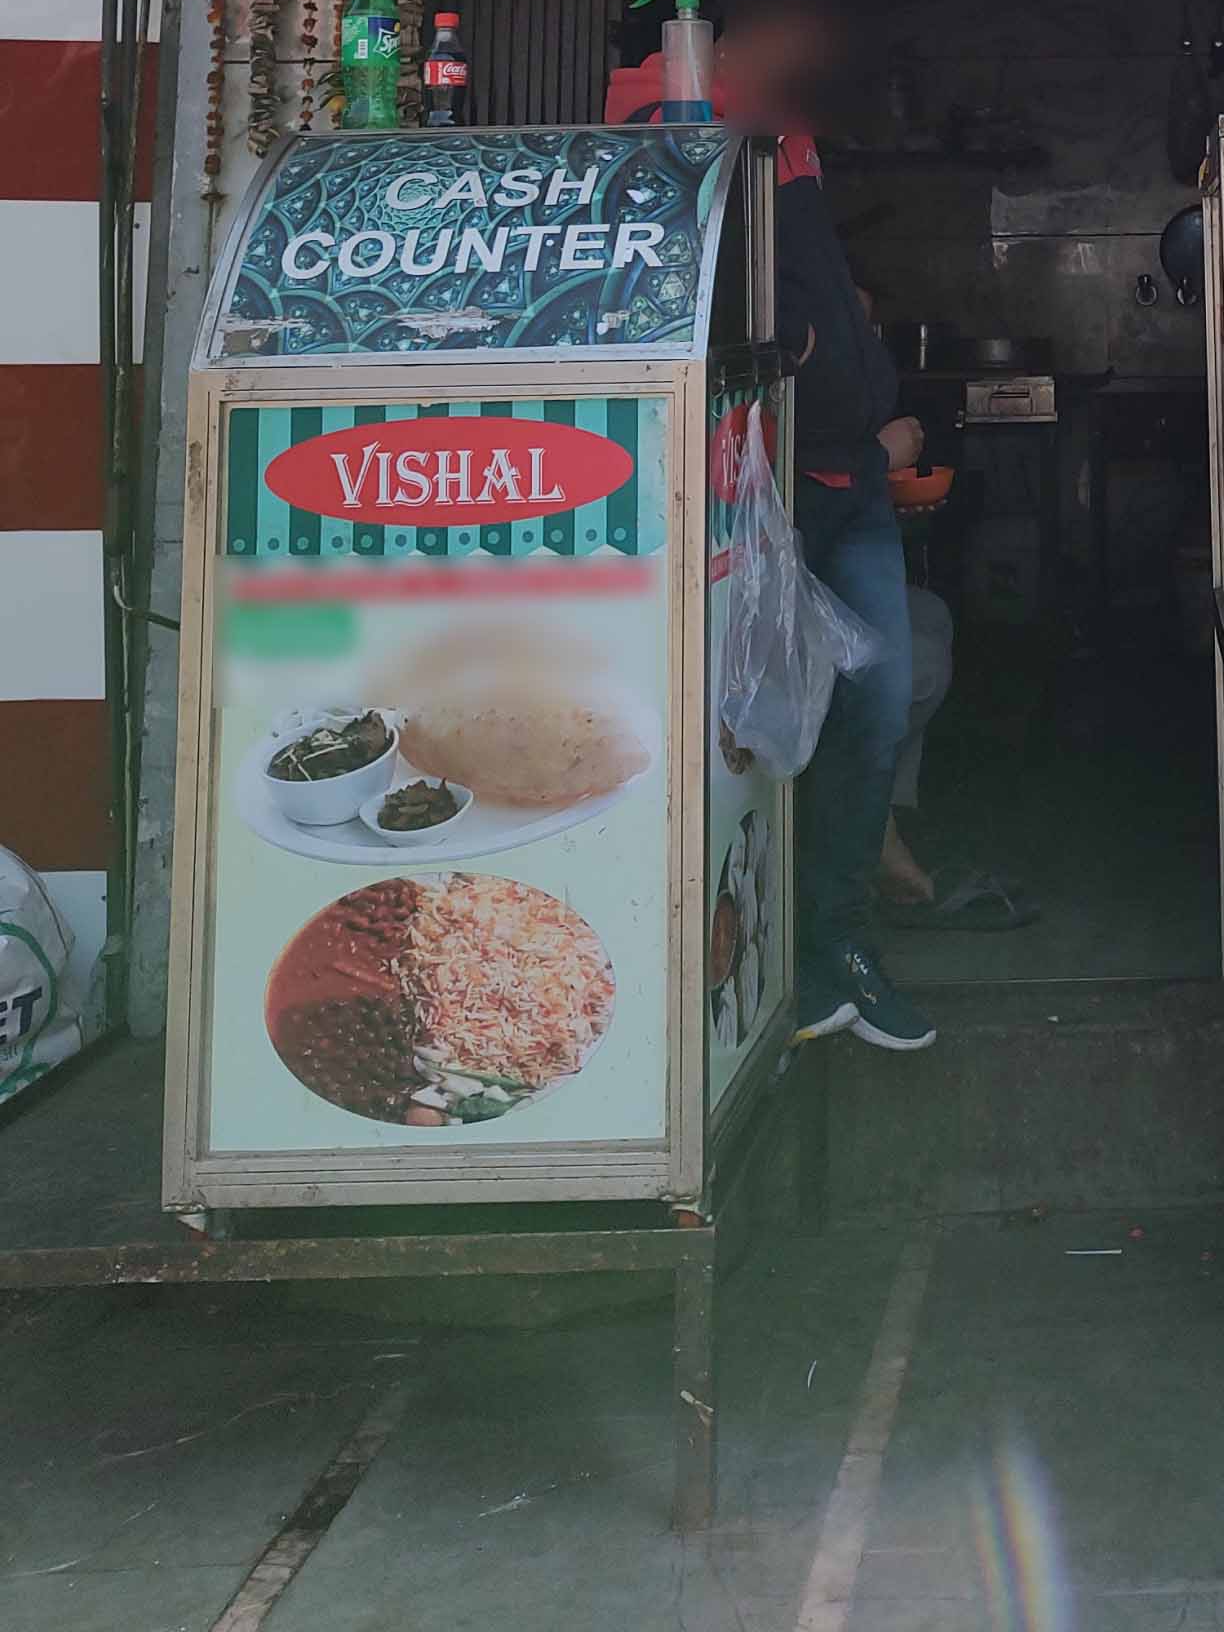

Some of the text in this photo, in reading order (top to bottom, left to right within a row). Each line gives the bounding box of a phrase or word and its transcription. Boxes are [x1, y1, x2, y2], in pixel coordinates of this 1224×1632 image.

[385, 168, 600, 212] CASH
[280, 222, 665, 280] COUNTER
[330, 440, 567, 509] VISHAL
